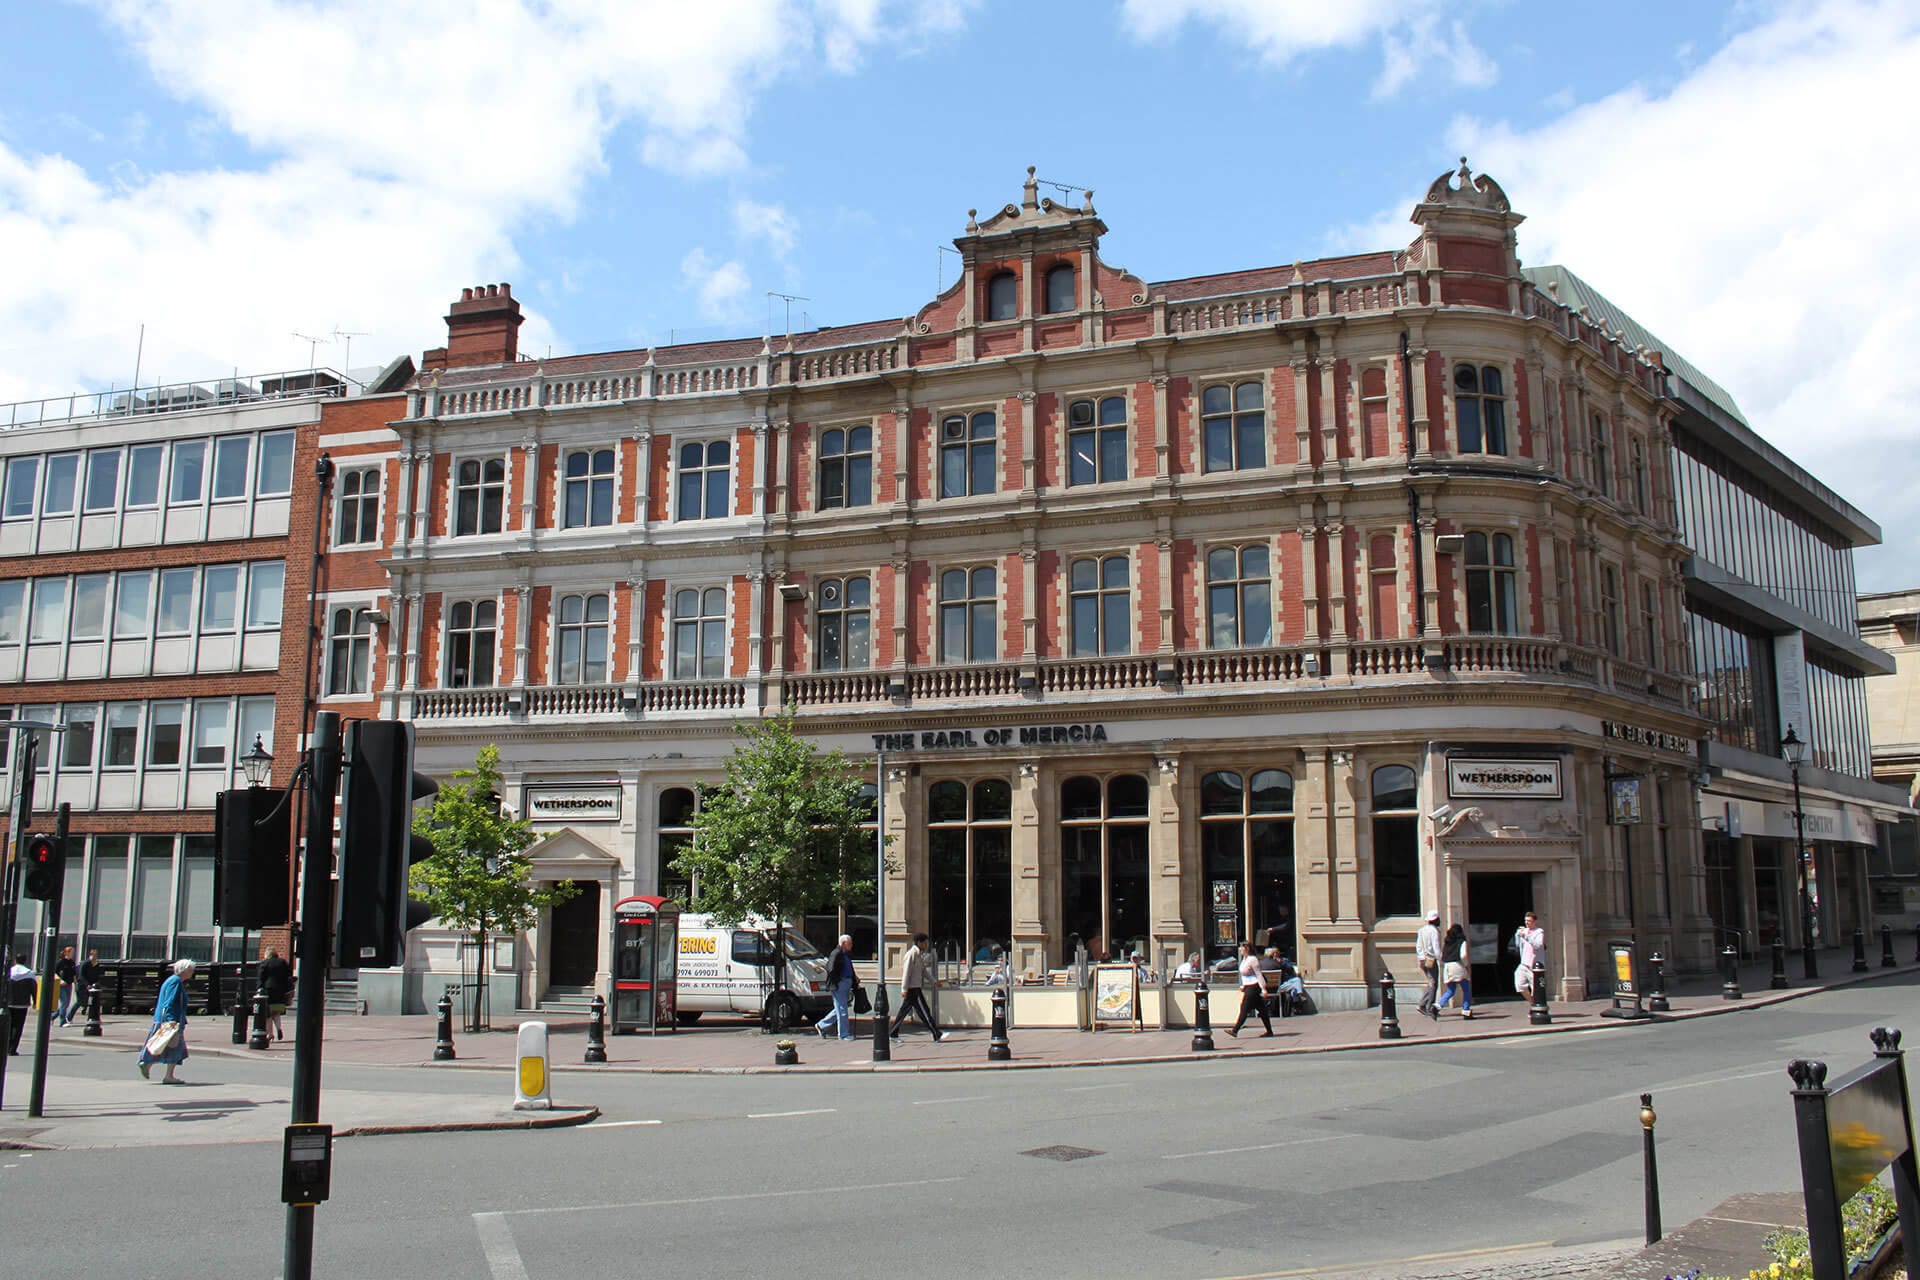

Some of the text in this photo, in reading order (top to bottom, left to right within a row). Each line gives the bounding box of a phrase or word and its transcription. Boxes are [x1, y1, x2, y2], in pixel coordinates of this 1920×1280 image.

[872, 724, 1107, 750] THE EARL OF MERCIA
[1458, 773, 1553, 784] WETHERSPOON
[534, 799, 613, 809] WETHERSPOON
[1791, 813, 1834, 834] CVENTRY
